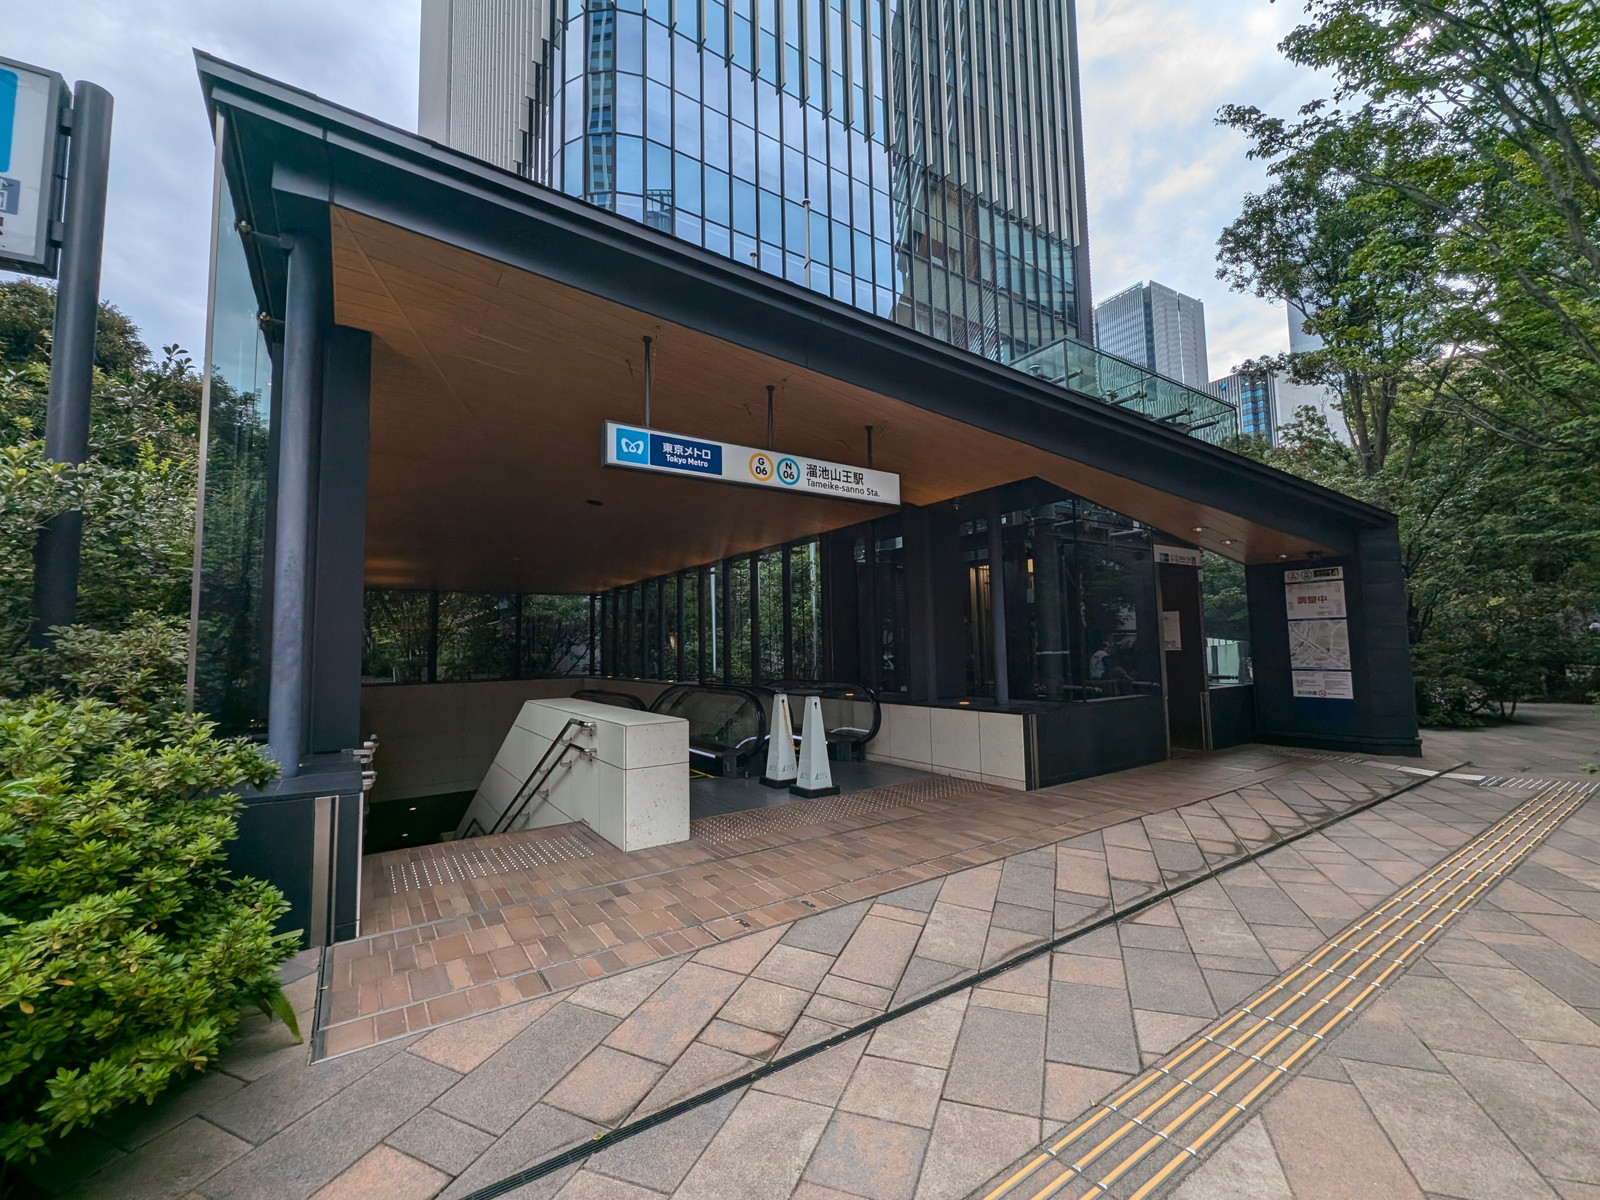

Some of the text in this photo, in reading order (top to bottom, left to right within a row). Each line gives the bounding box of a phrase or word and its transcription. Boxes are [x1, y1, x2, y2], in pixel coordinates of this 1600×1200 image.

[662, 442, 711, 459] 東京メトロ
[666, 453, 709, 468] Tokyo Metro
[757, 457, 765, 466] G
[785, 461, 792, 471] N
[755, 465, 768, 476] 06
[783, 470, 795, 480] 06
[806, 463, 864, 486] 溜池山王駅
[806, 478, 881, 498] Tameike-sanno Sta.
